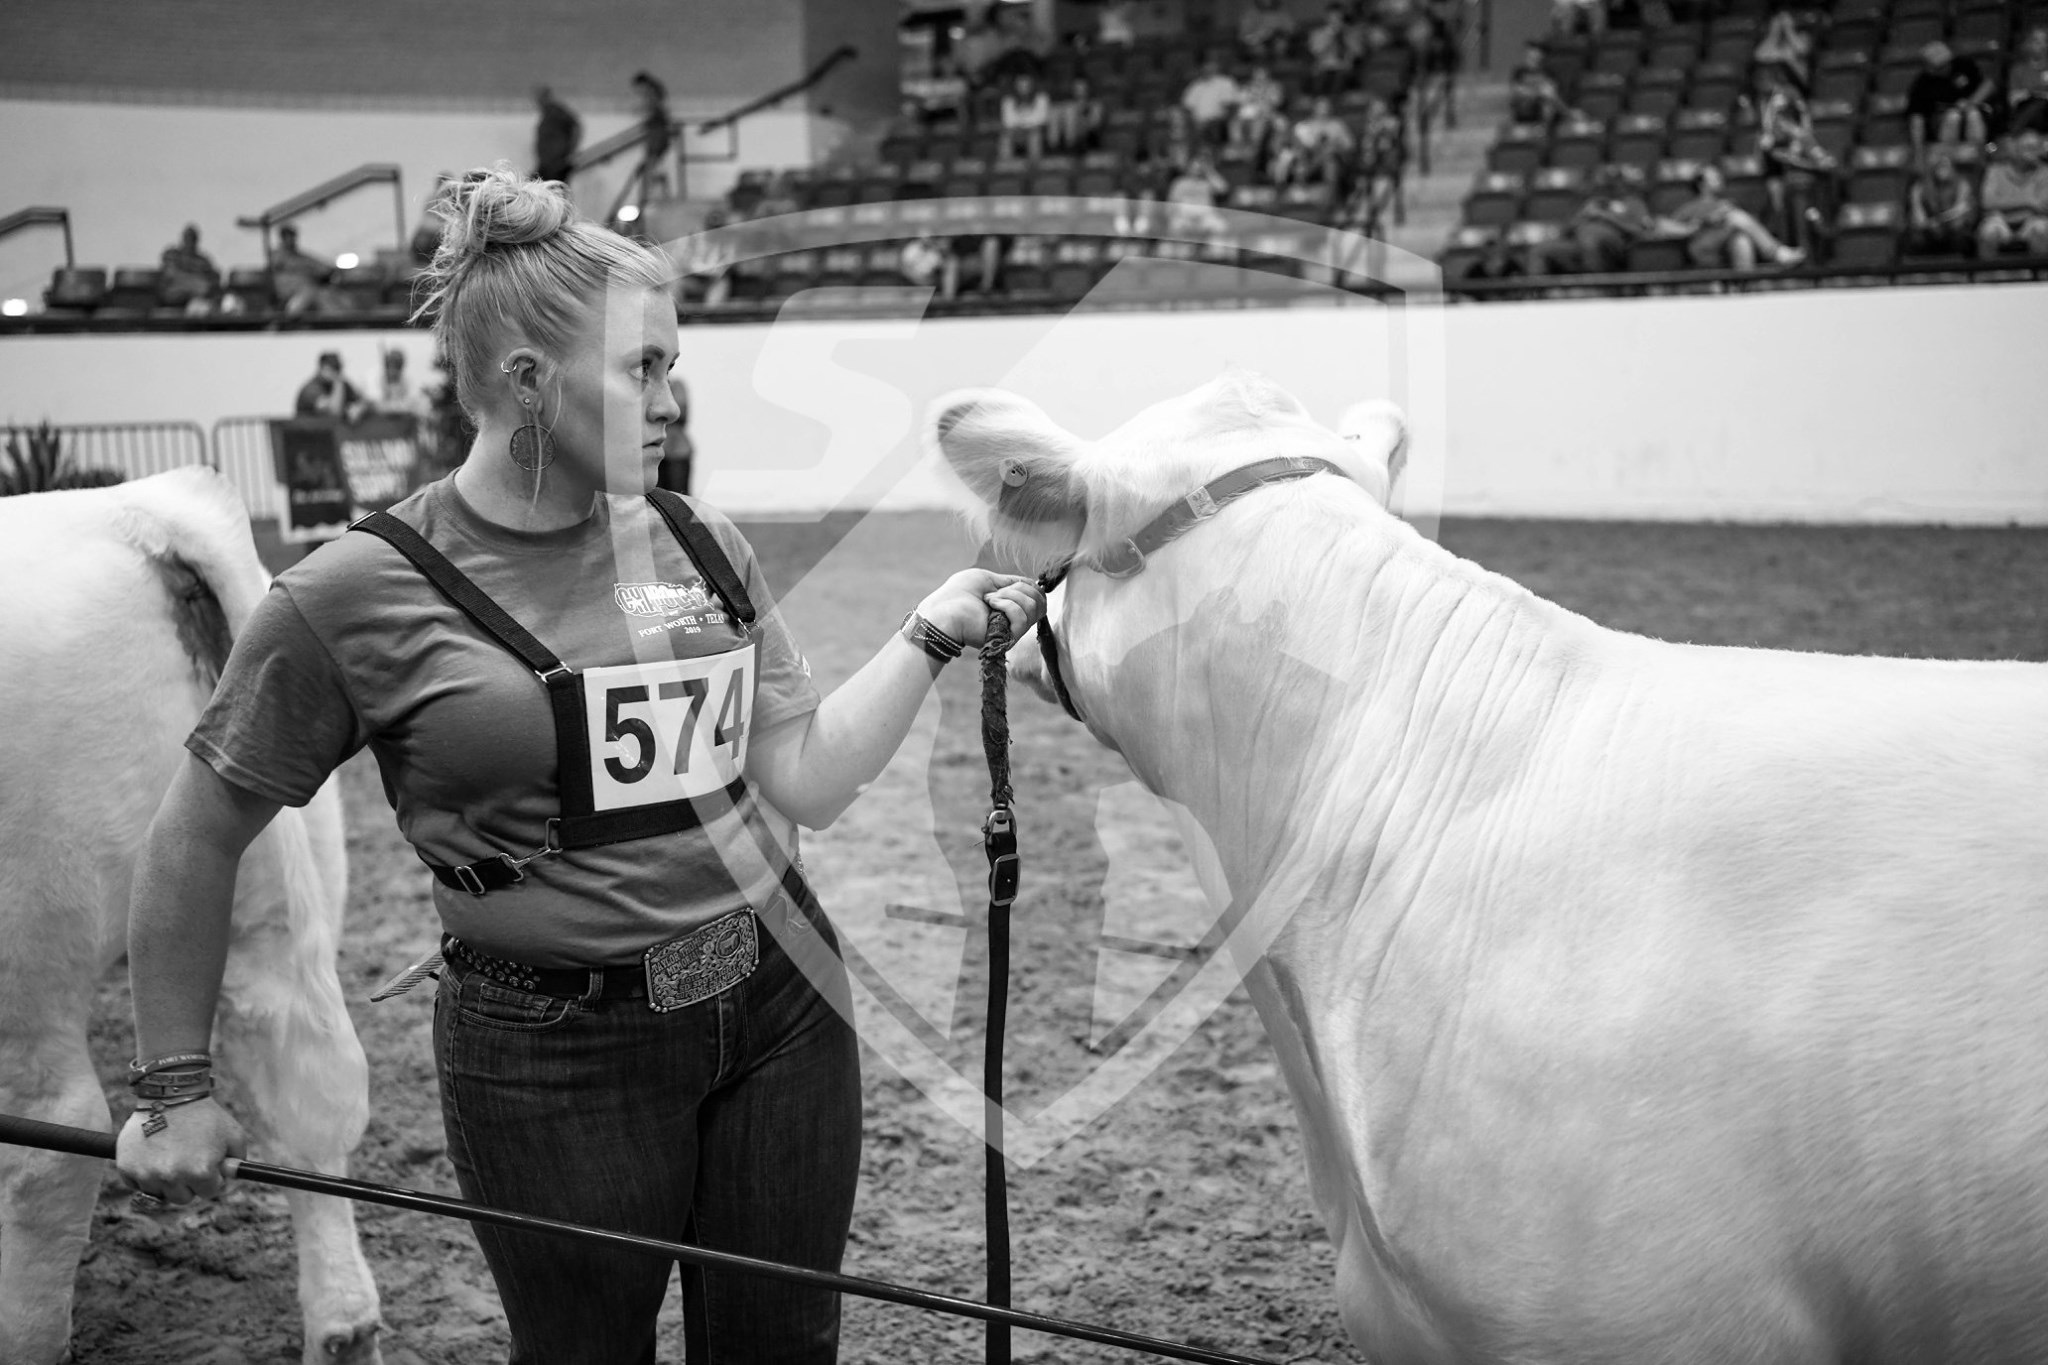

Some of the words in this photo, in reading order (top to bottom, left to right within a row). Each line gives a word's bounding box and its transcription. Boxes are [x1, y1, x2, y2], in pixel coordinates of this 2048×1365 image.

[638, 625, 663, 637] FORT
[664, 615, 697, 630] WORTH
[683, 626, 702, 634] 2019
[603, 667, 745, 784] 574
[652, 952, 680, 973] TAYLOR
